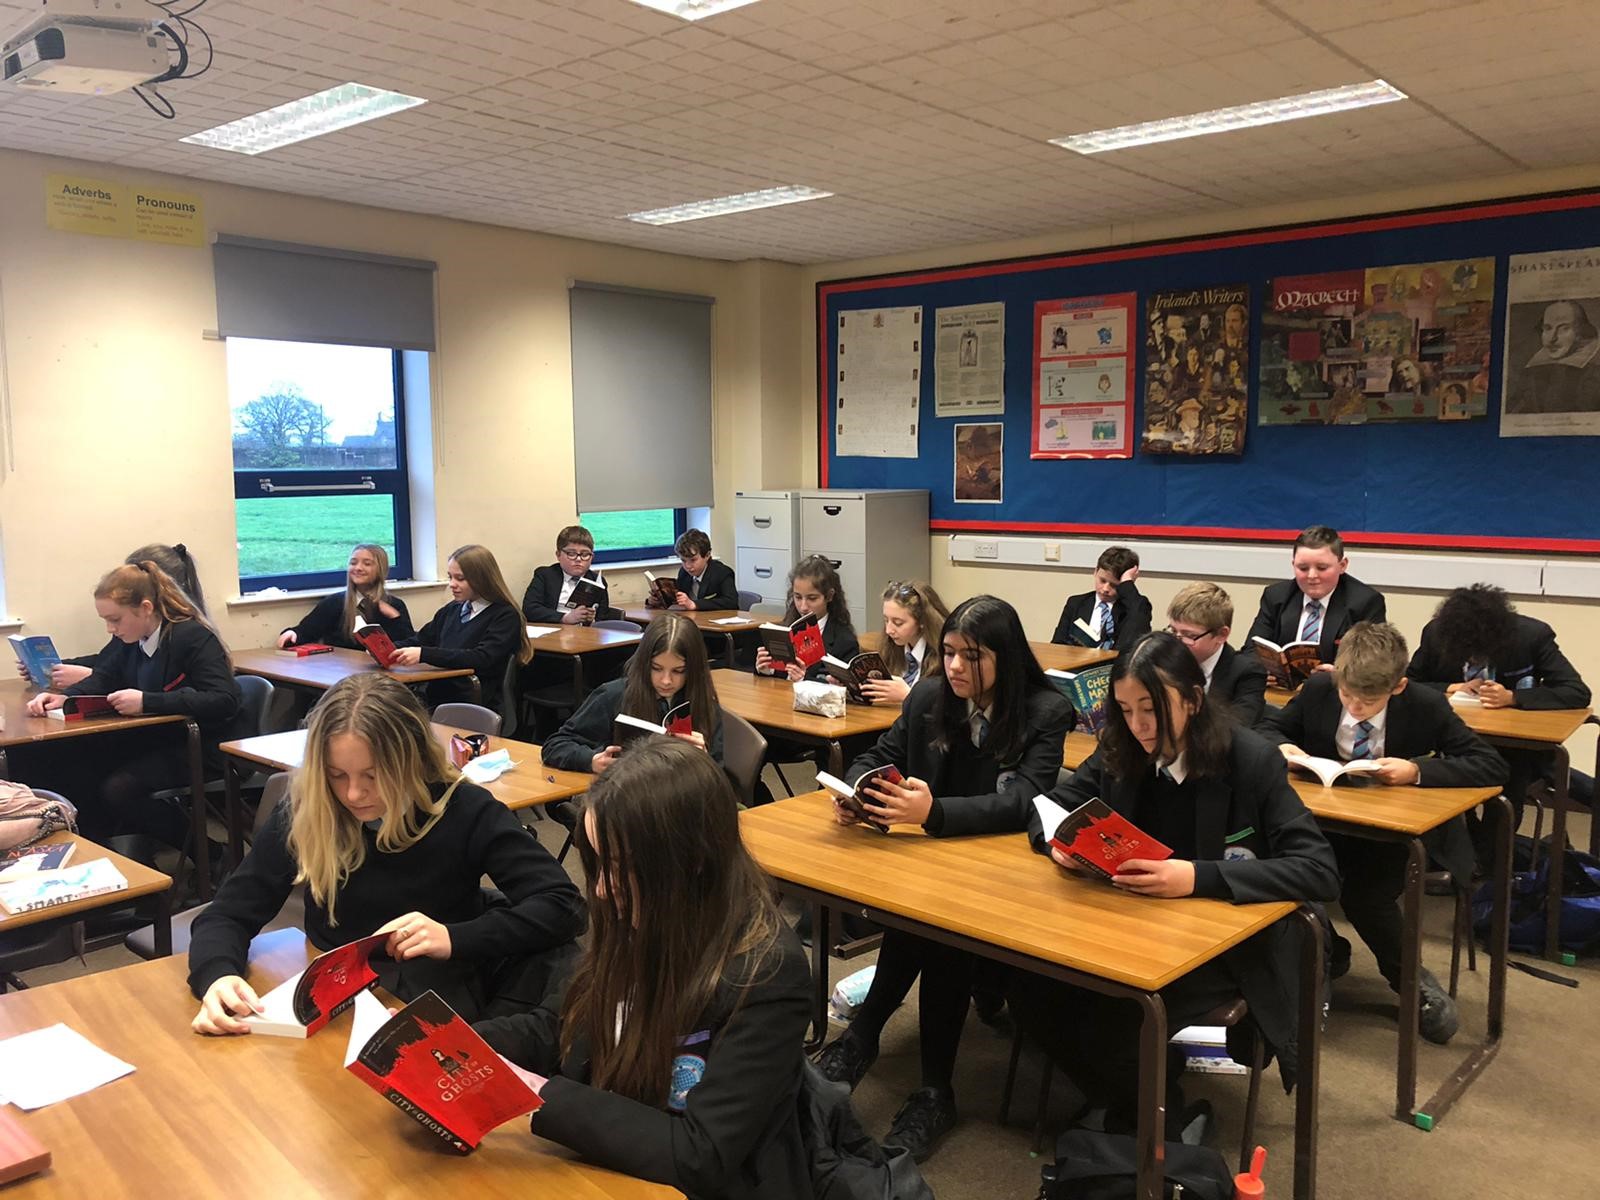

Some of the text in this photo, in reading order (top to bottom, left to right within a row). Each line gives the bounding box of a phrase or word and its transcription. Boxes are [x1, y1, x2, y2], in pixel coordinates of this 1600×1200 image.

[62, 184, 112, 201] Adverbs
[136, 194, 196, 213] Pronouns
[1154, 287, 1244, 309] Ireland's Writers
[1275, 289, 1360, 311] MACBETH
[1086, 675, 1111, 689] CHEC
[26, 894, 73, 912] SMART
[437, 1063, 474, 1091] CITY
[440, 1065, 494, 1102] GHOSTS
[389, 1093, 415, 1112] CITY
[416, 1113, 453, 1142] GHOSTS
